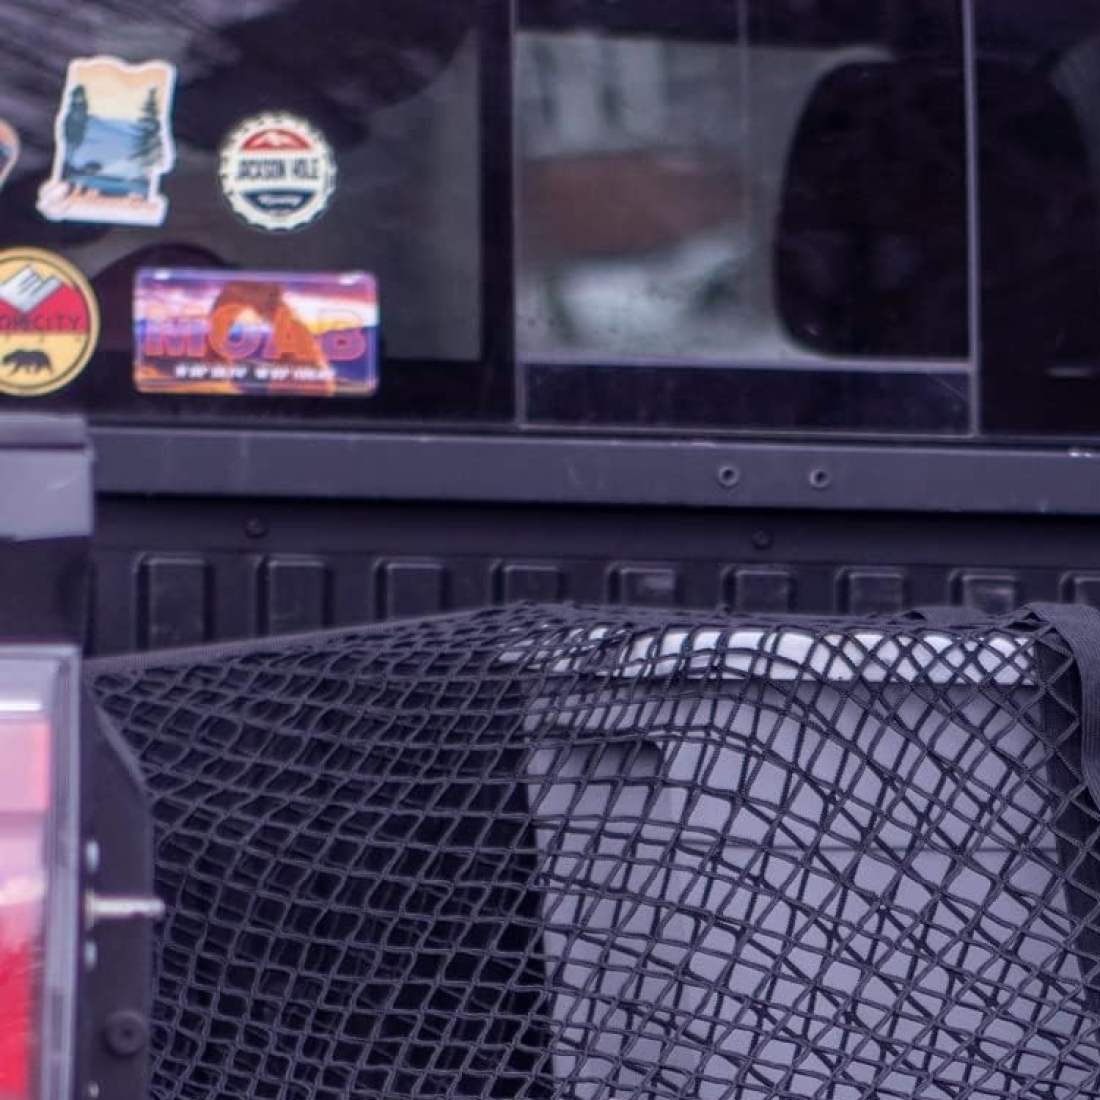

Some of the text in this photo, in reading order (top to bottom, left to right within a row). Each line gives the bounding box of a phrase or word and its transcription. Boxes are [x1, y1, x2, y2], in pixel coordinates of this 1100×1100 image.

[238, 158, 320, 179] JACKSON HOLE
[143, 303, 368, 361] MOAB
